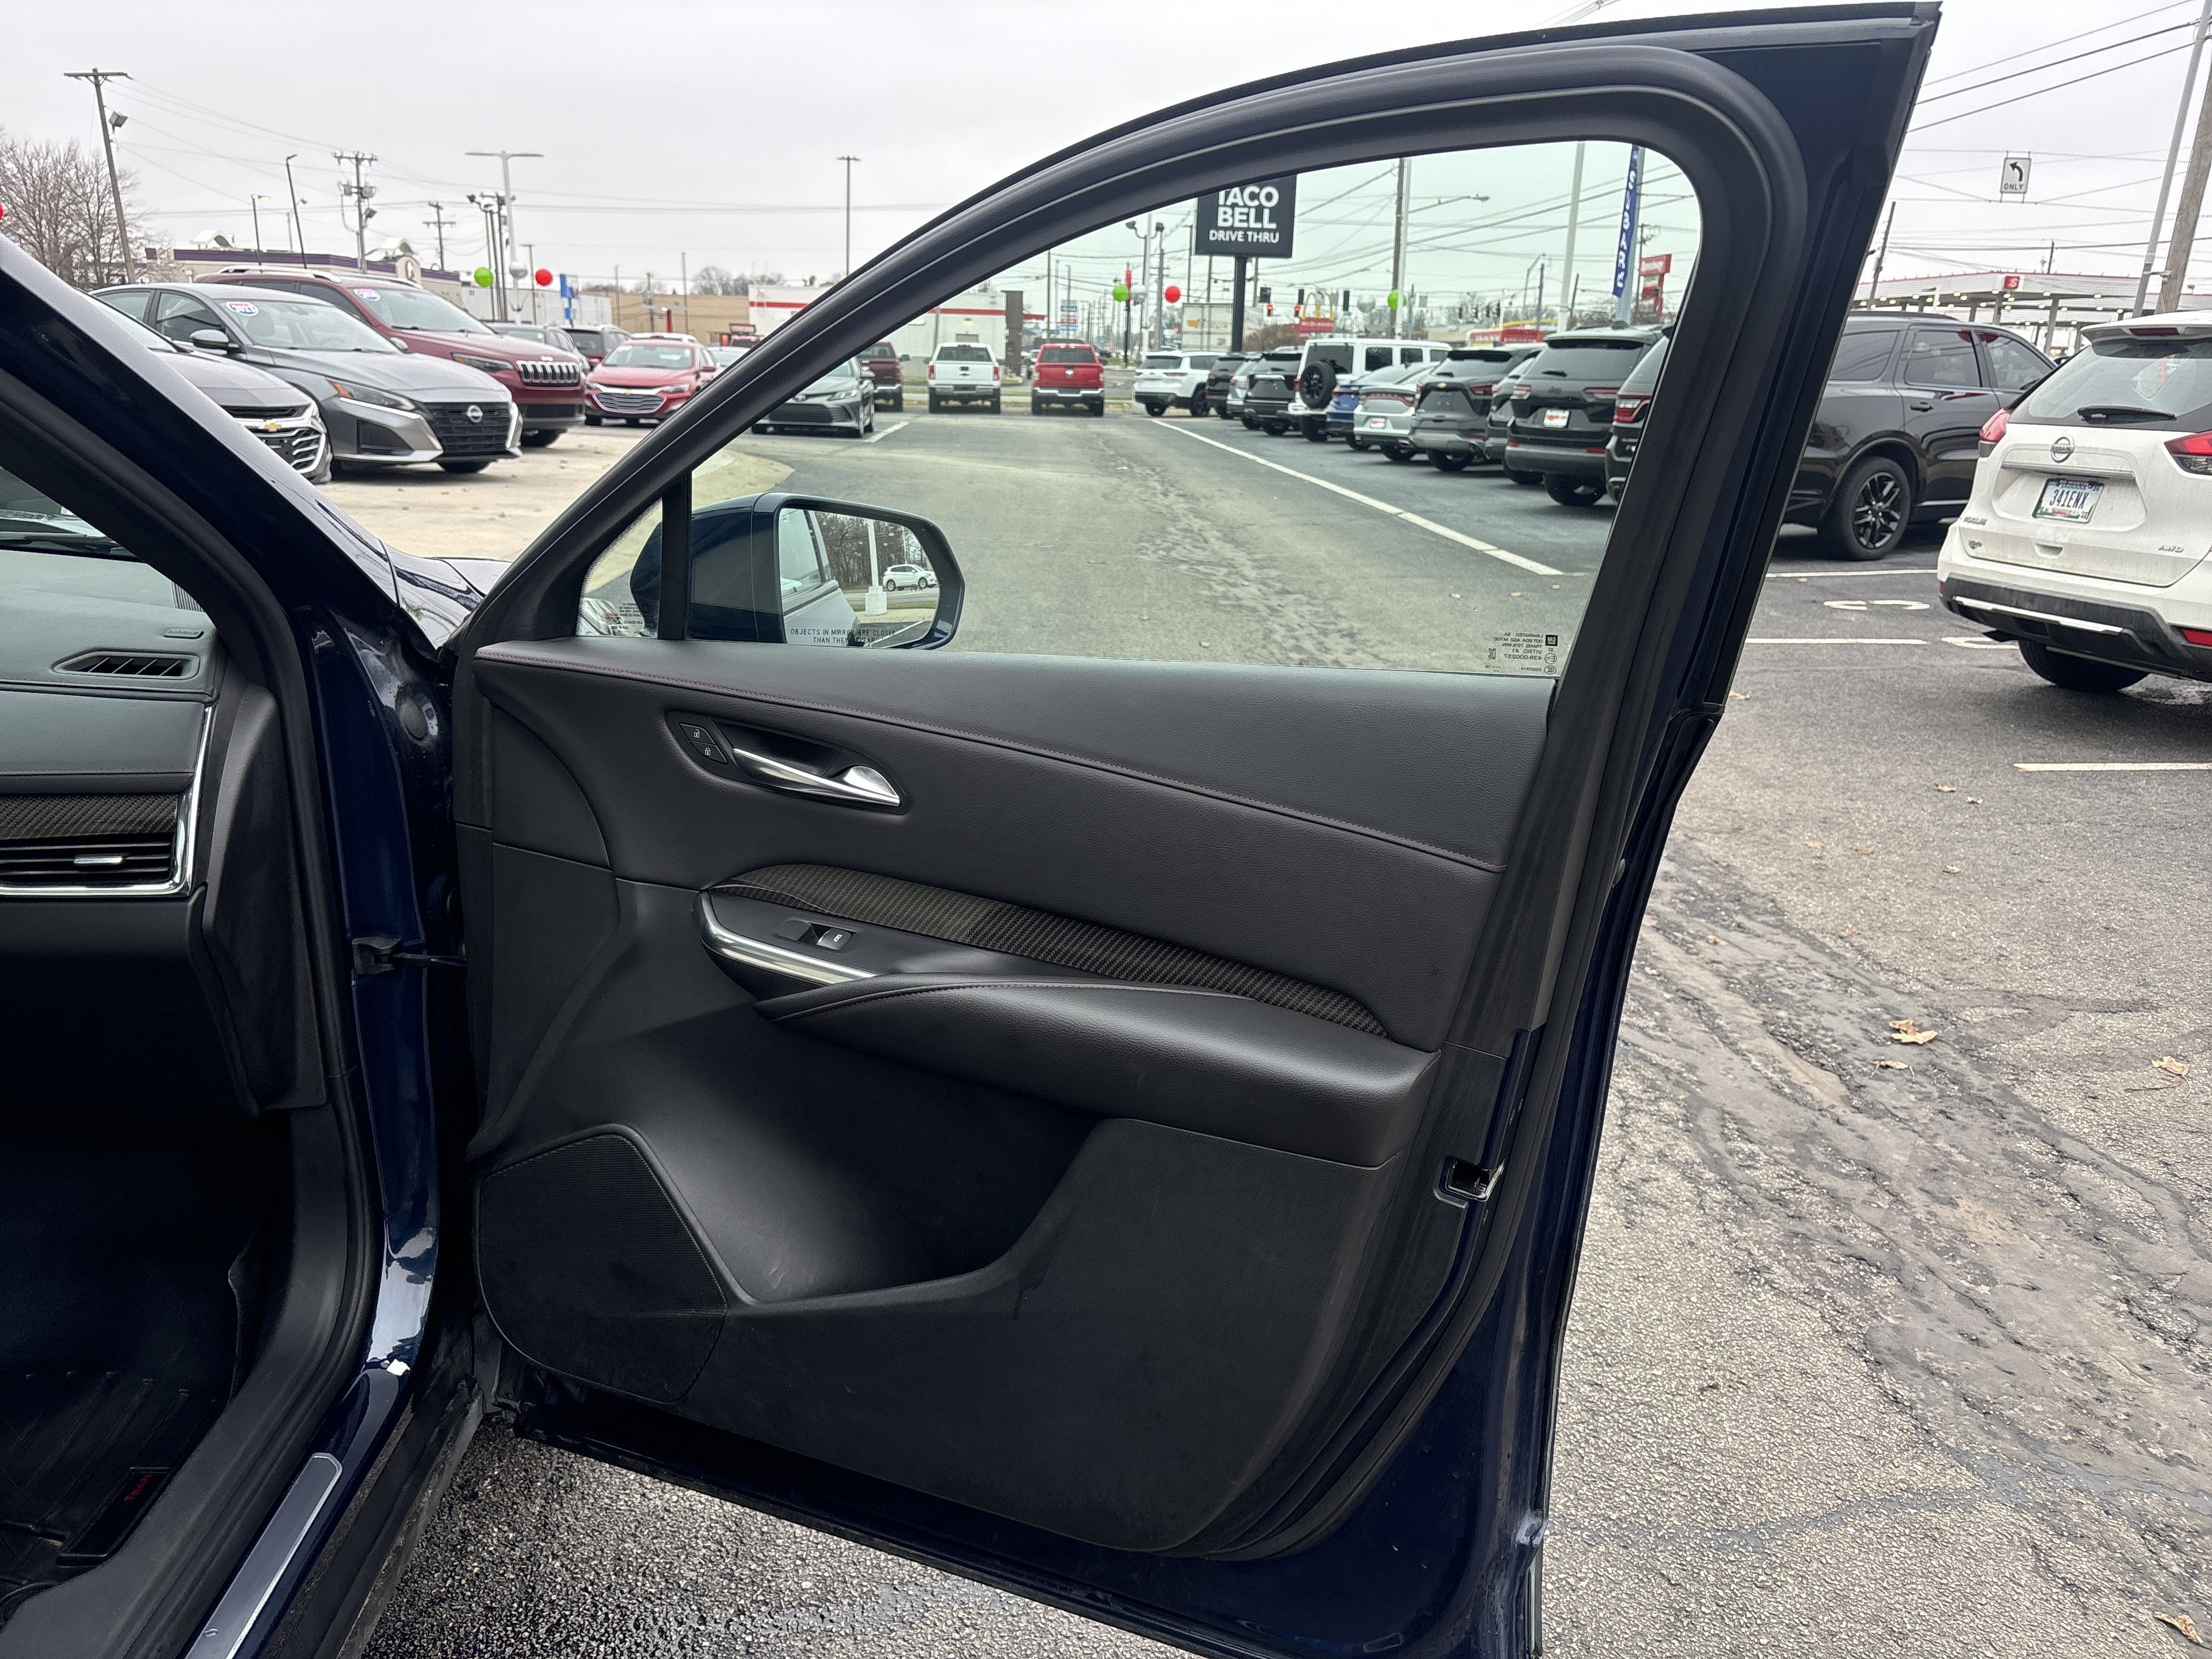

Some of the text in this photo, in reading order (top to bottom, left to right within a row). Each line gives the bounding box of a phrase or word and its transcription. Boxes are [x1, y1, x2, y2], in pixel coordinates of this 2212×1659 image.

[1218, 185, 1279, 207] TACO
[1217, 206, 1277, 229] BELL
[1209, 229, 1279, 243] DRIVE THRU
[2049, 489, 2089, 509] 341ENX
